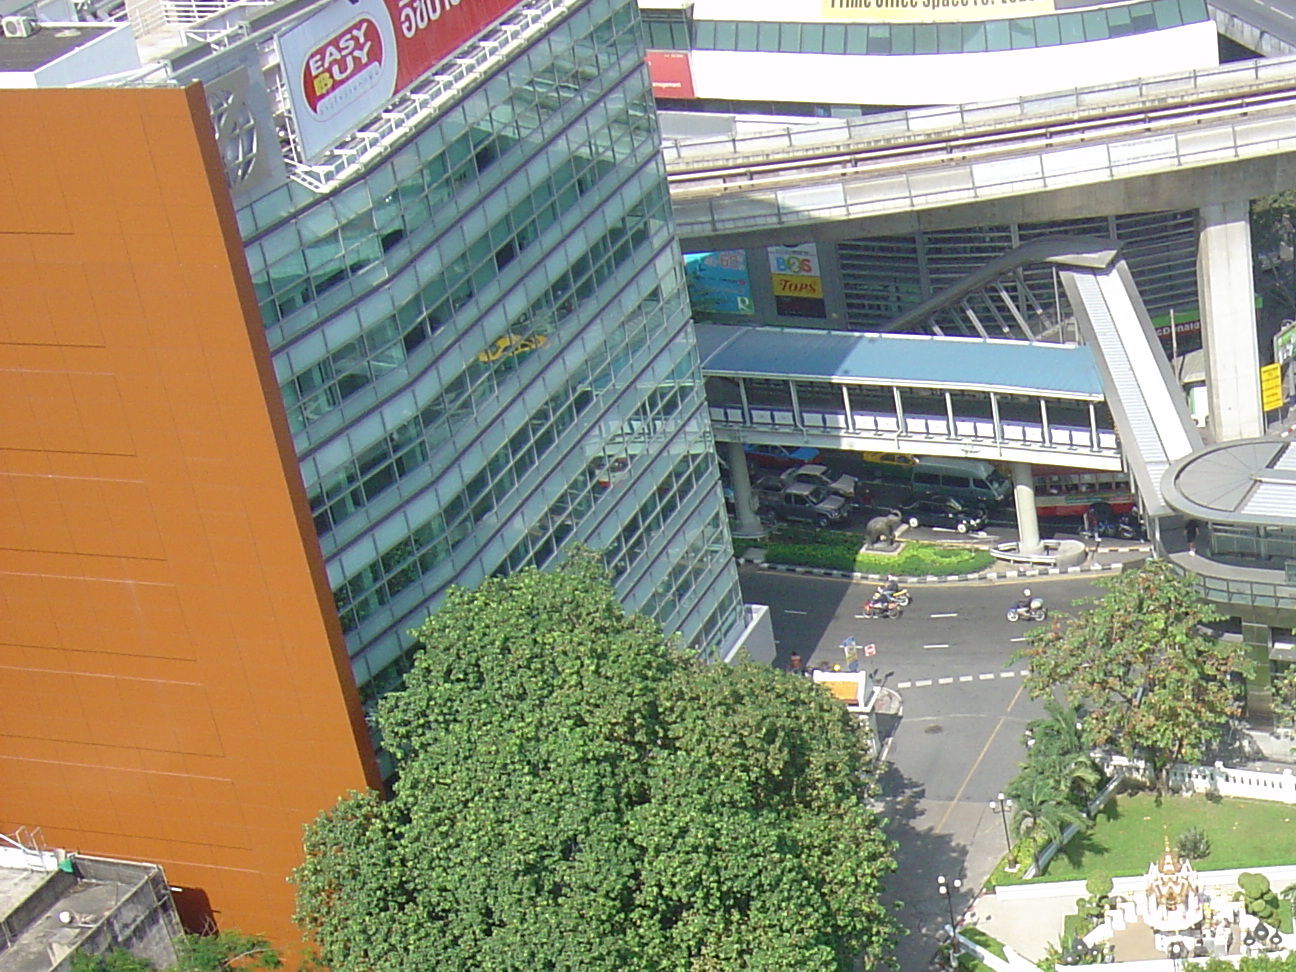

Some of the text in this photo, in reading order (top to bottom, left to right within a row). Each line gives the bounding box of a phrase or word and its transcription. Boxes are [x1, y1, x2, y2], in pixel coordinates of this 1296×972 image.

[309, 22, 368, 76] EASY
[313, 41, 372, 96] BUY
[1156, 320, 1200, 336] cDnald
